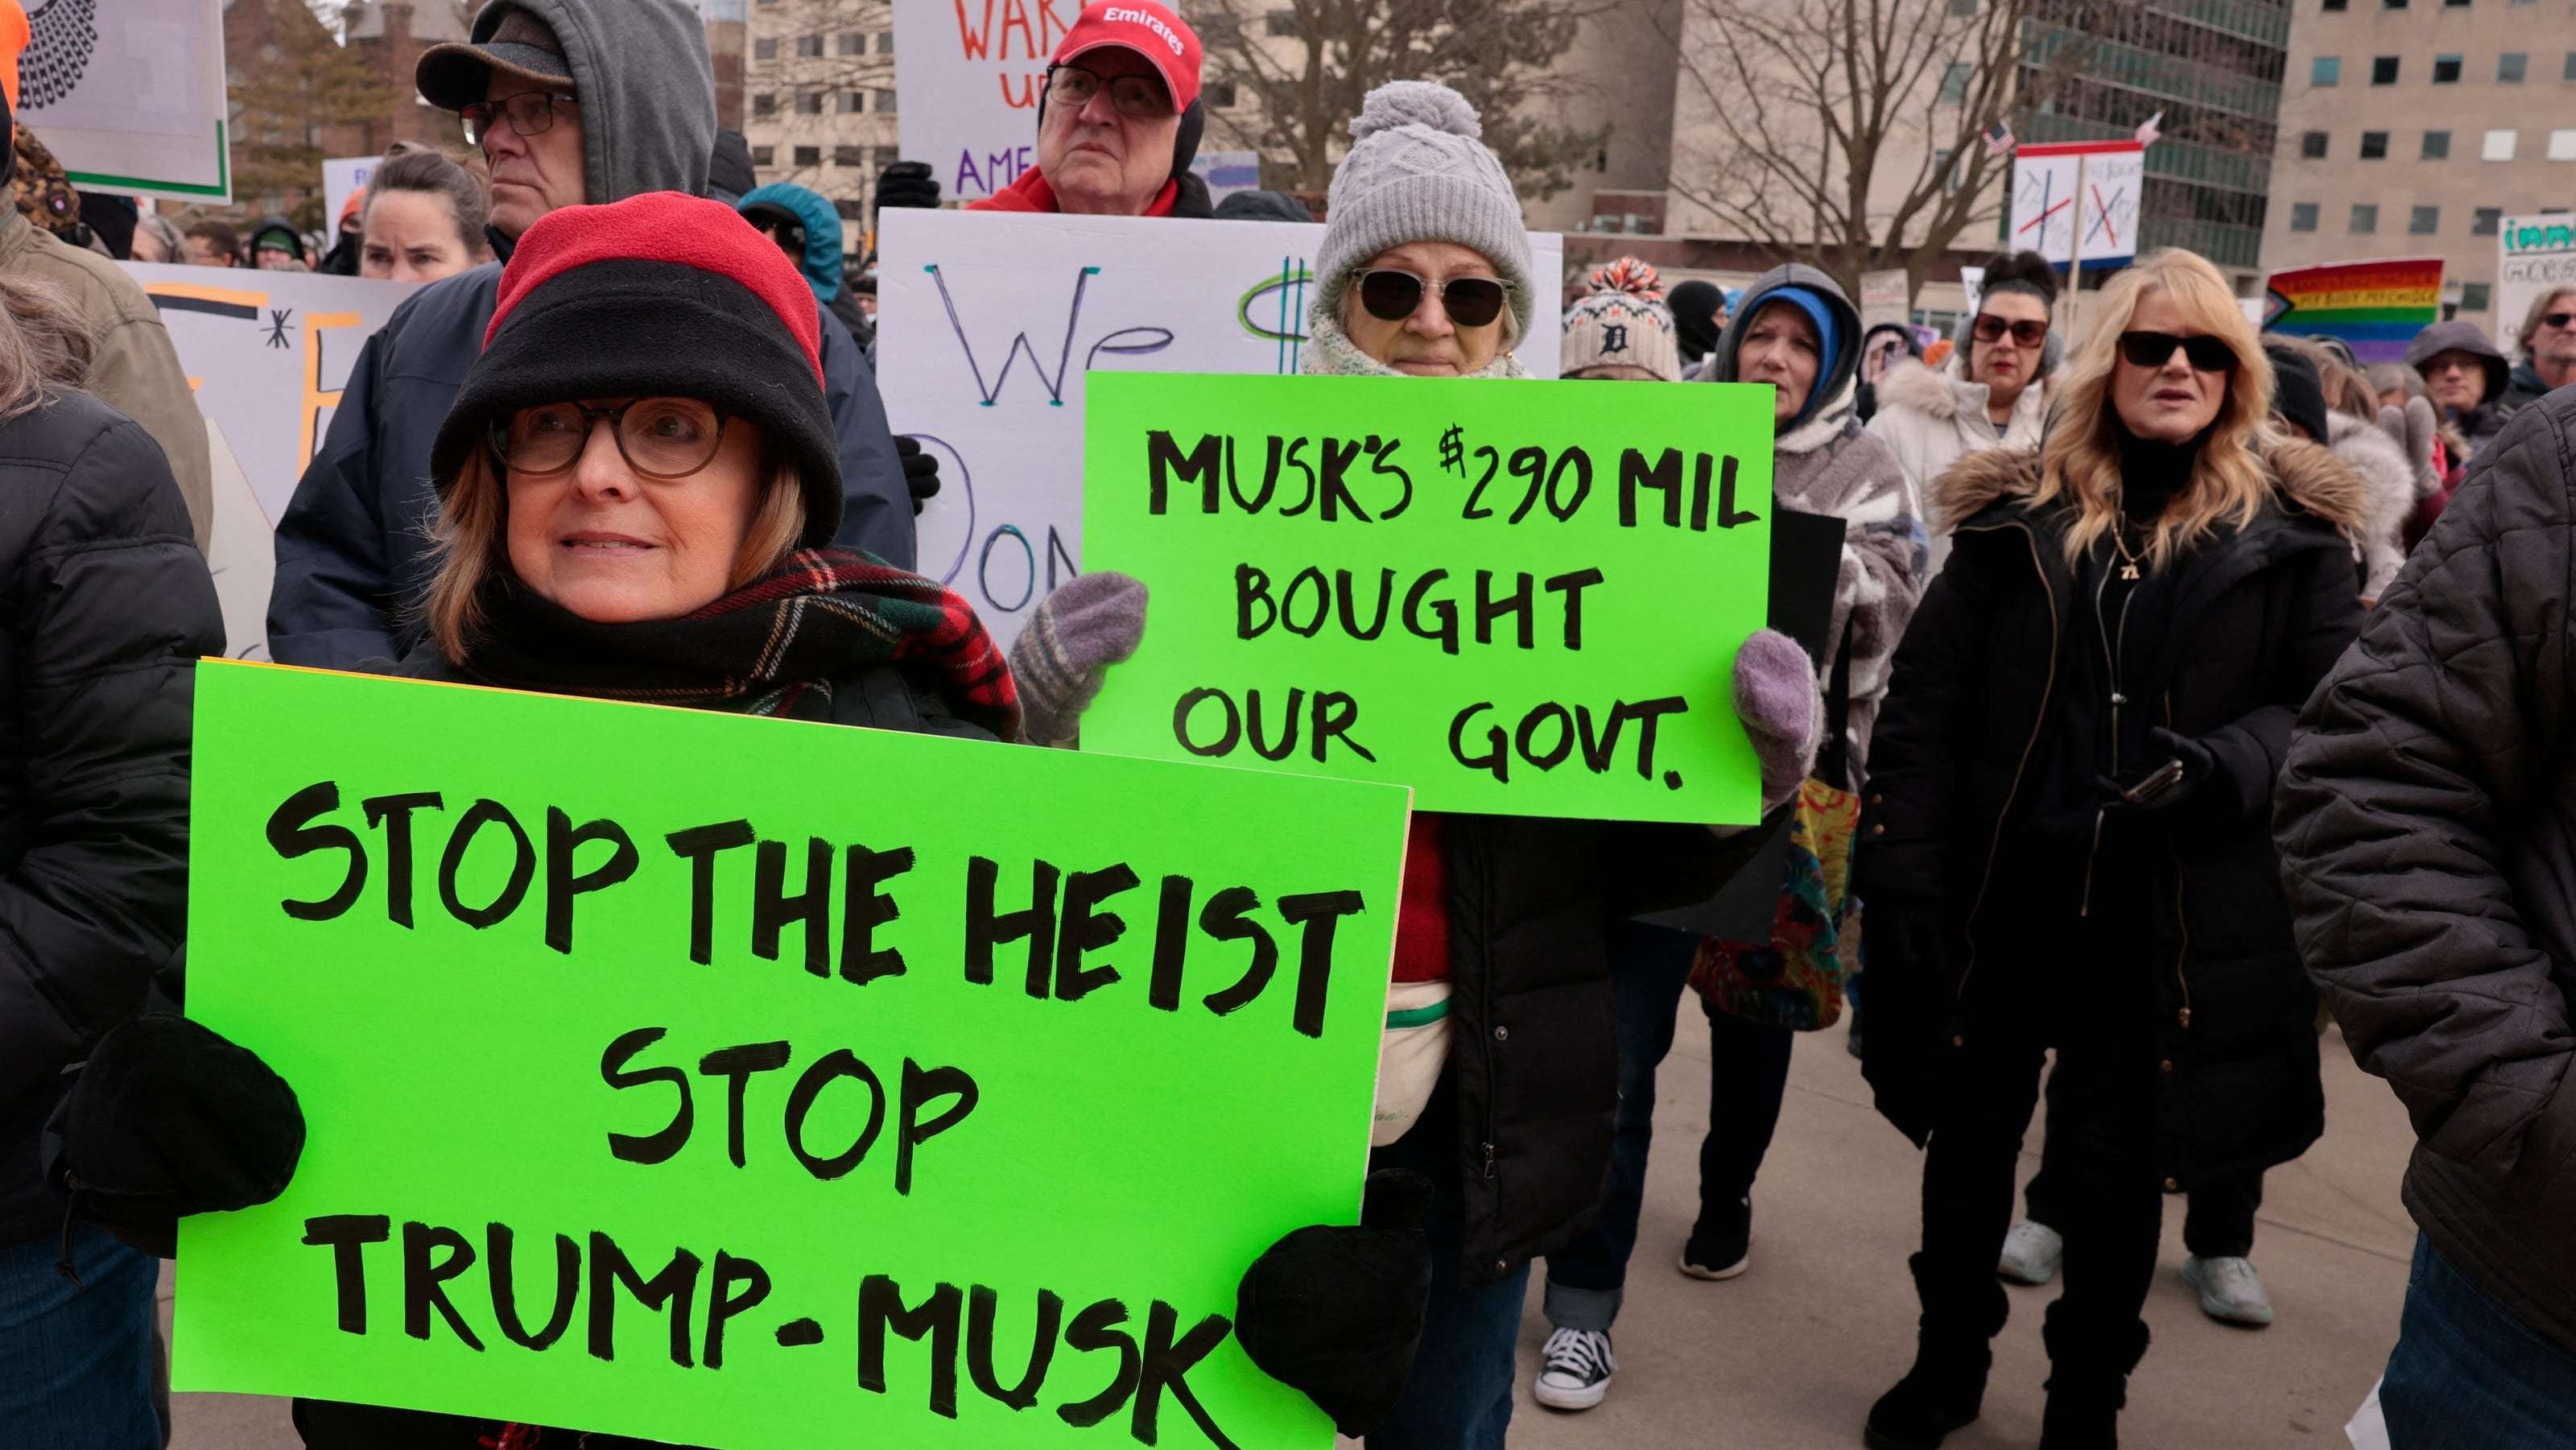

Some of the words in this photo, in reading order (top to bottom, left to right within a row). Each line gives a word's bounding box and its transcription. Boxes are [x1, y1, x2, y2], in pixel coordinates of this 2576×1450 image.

[953, 0, 1087, 60] WAK
[1104, 6, 1185, 57] Emirates
[923, 265, 1174, 407] We
[1598, 323, 1629, 357] D
[1147, 430, 1413, 523] MUSK'S
[1439, 424, 1592, 525] $290
[1619, 448, 1761, 532] MIL
[1235, 563, 1604, 655] BOUGHT
[1173, 688, 1377, 763] OUR
[1448, 696, 1689, 791] GOVT.
[266, 780, 639, 955] STOP
[666, 819, 916, 987] THE
[964, 855, 1365, 1039] HEIST
[601, 1026, 980, 1196] STOP
